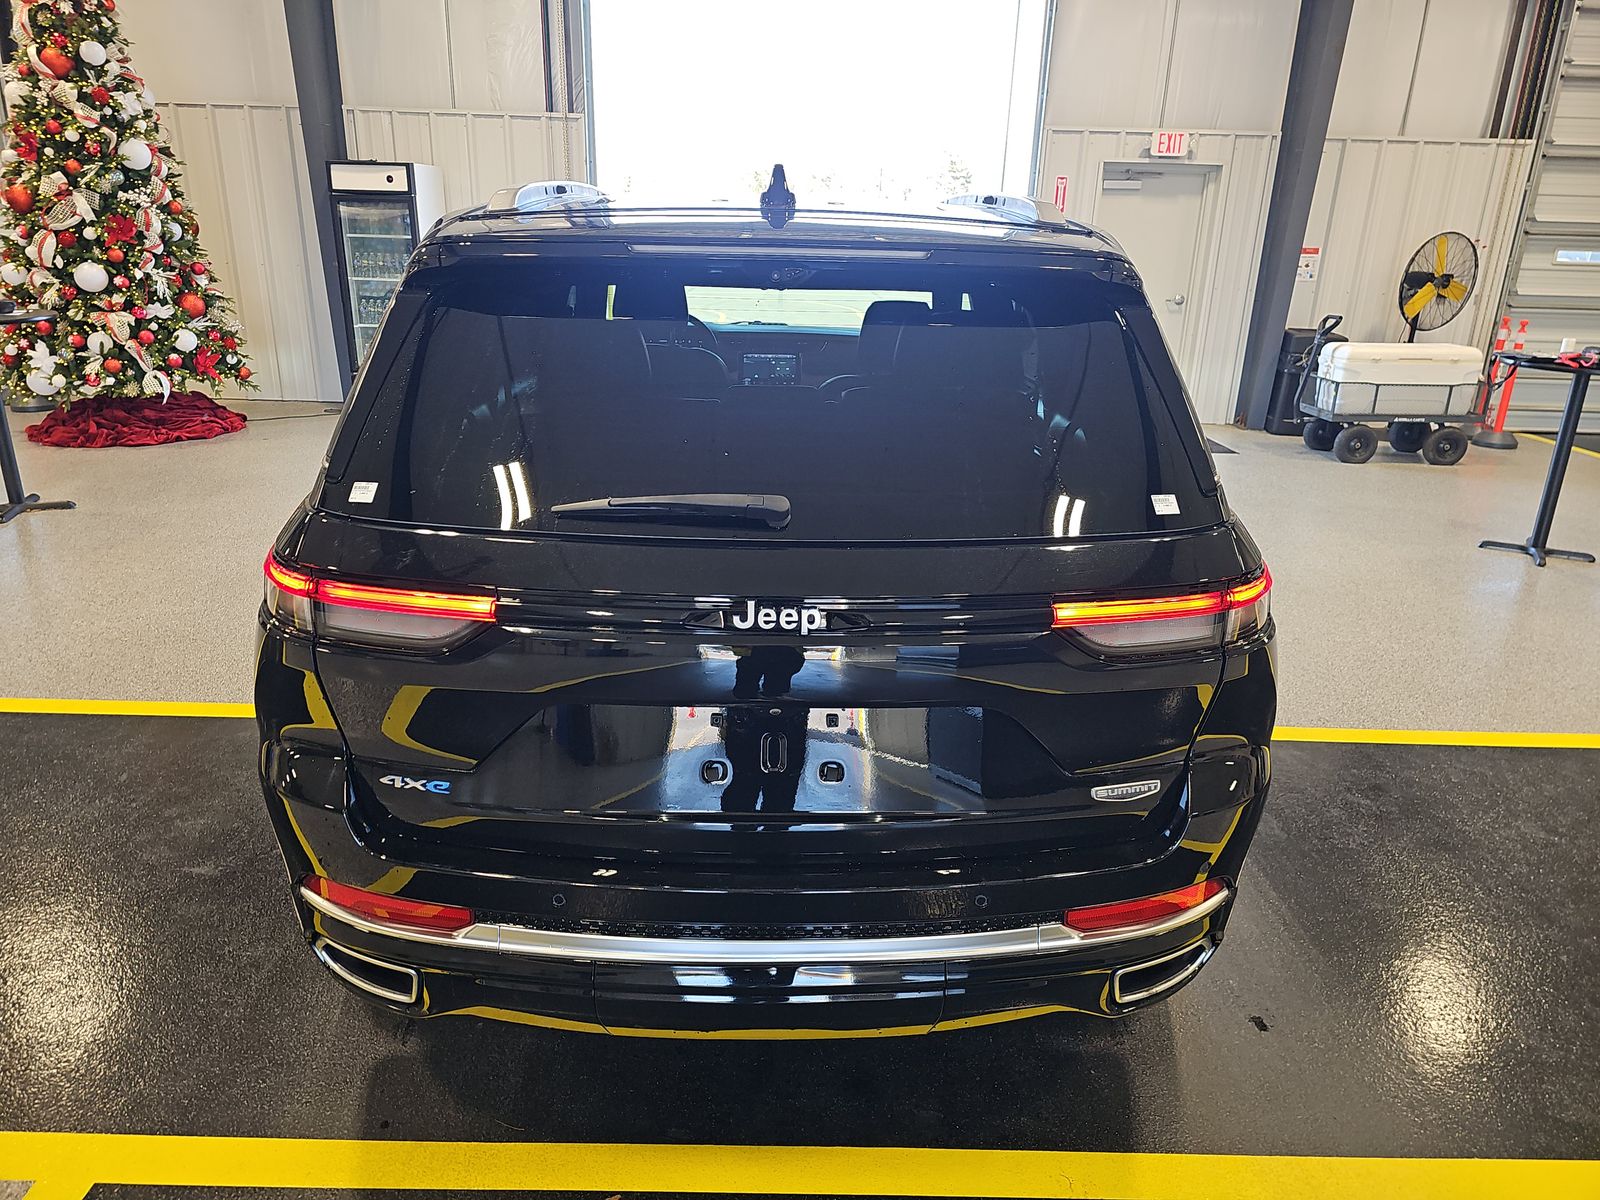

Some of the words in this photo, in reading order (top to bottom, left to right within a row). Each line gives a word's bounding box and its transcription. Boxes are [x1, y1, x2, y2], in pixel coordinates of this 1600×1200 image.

[1157, 133, 1185, 154] EXIT
[732, 600, 821, 635] Jeep
[1096, 783, 1158, 798] SUMMIT
